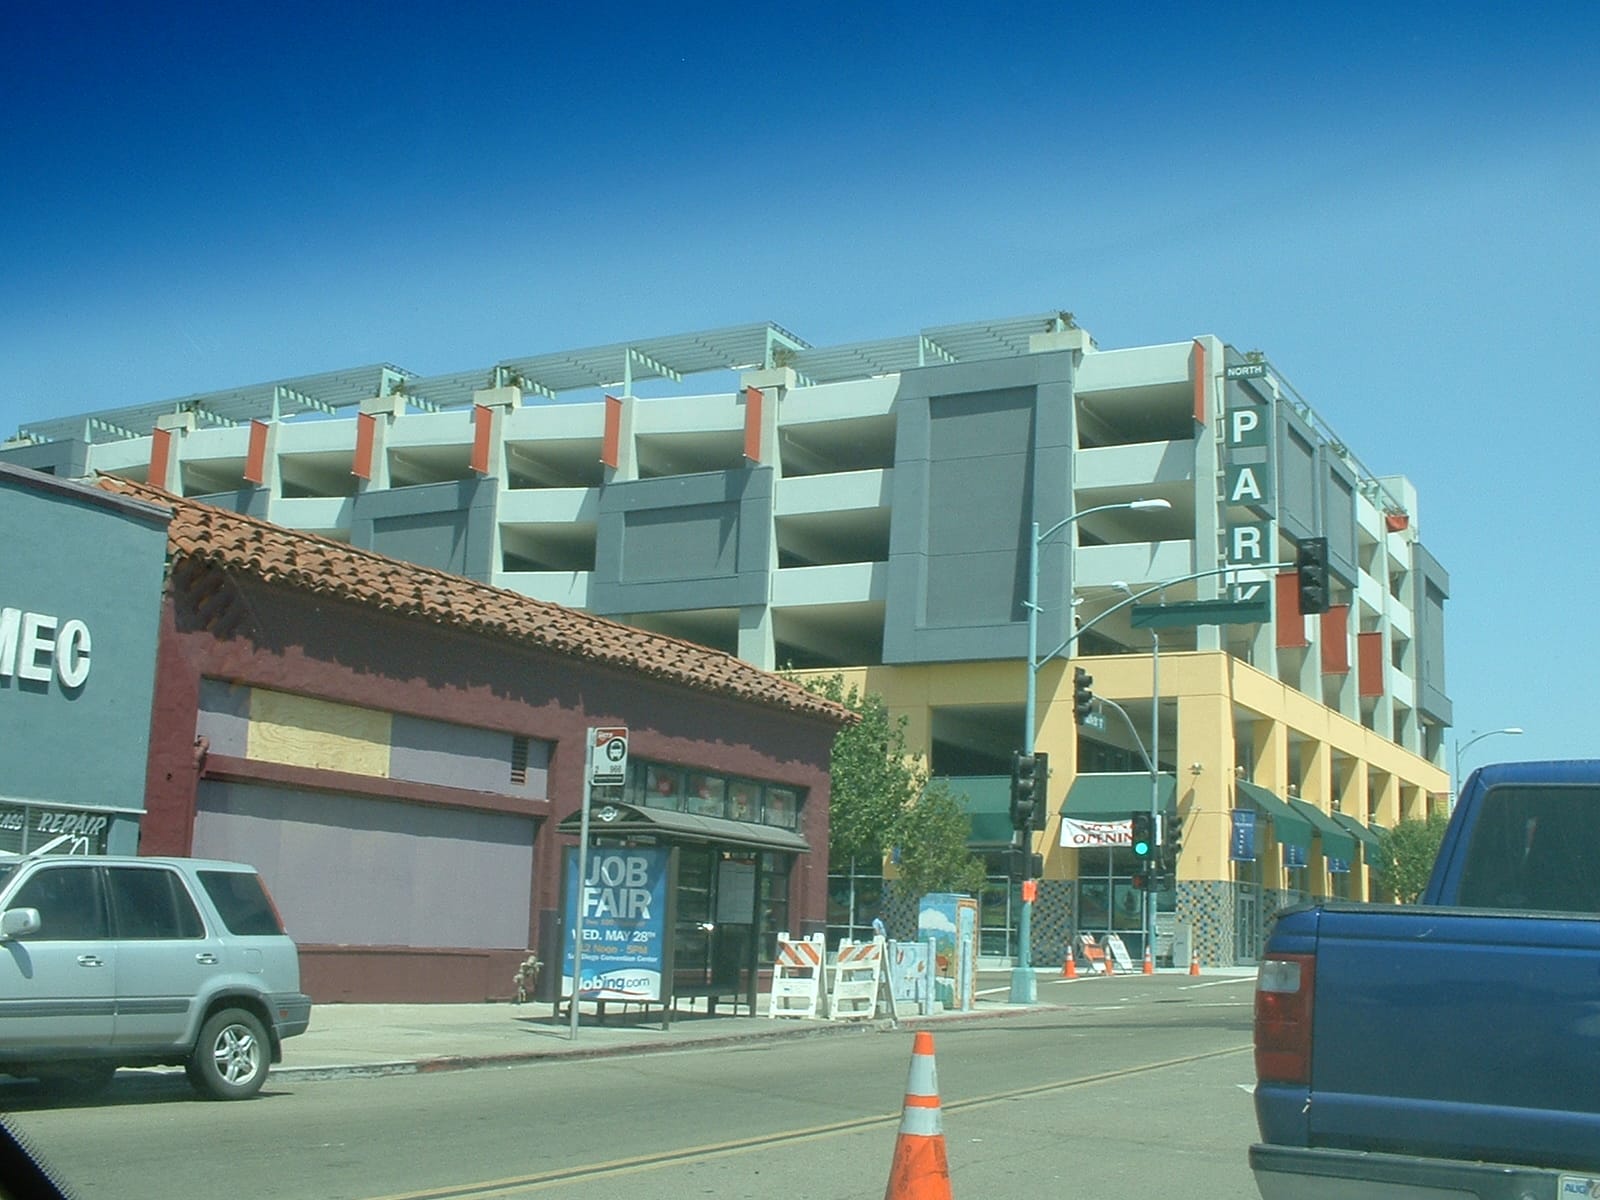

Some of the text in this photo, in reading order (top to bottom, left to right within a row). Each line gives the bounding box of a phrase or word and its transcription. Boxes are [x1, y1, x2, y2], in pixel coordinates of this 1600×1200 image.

[1227, 365, 1262, 378] NORTH
[37, 811, 107, 835] REPAIR
[584, 855, 649, 886] JOB
[582, 887, 652, 920] FAIR
[605, 930, 631, 942] MAY
